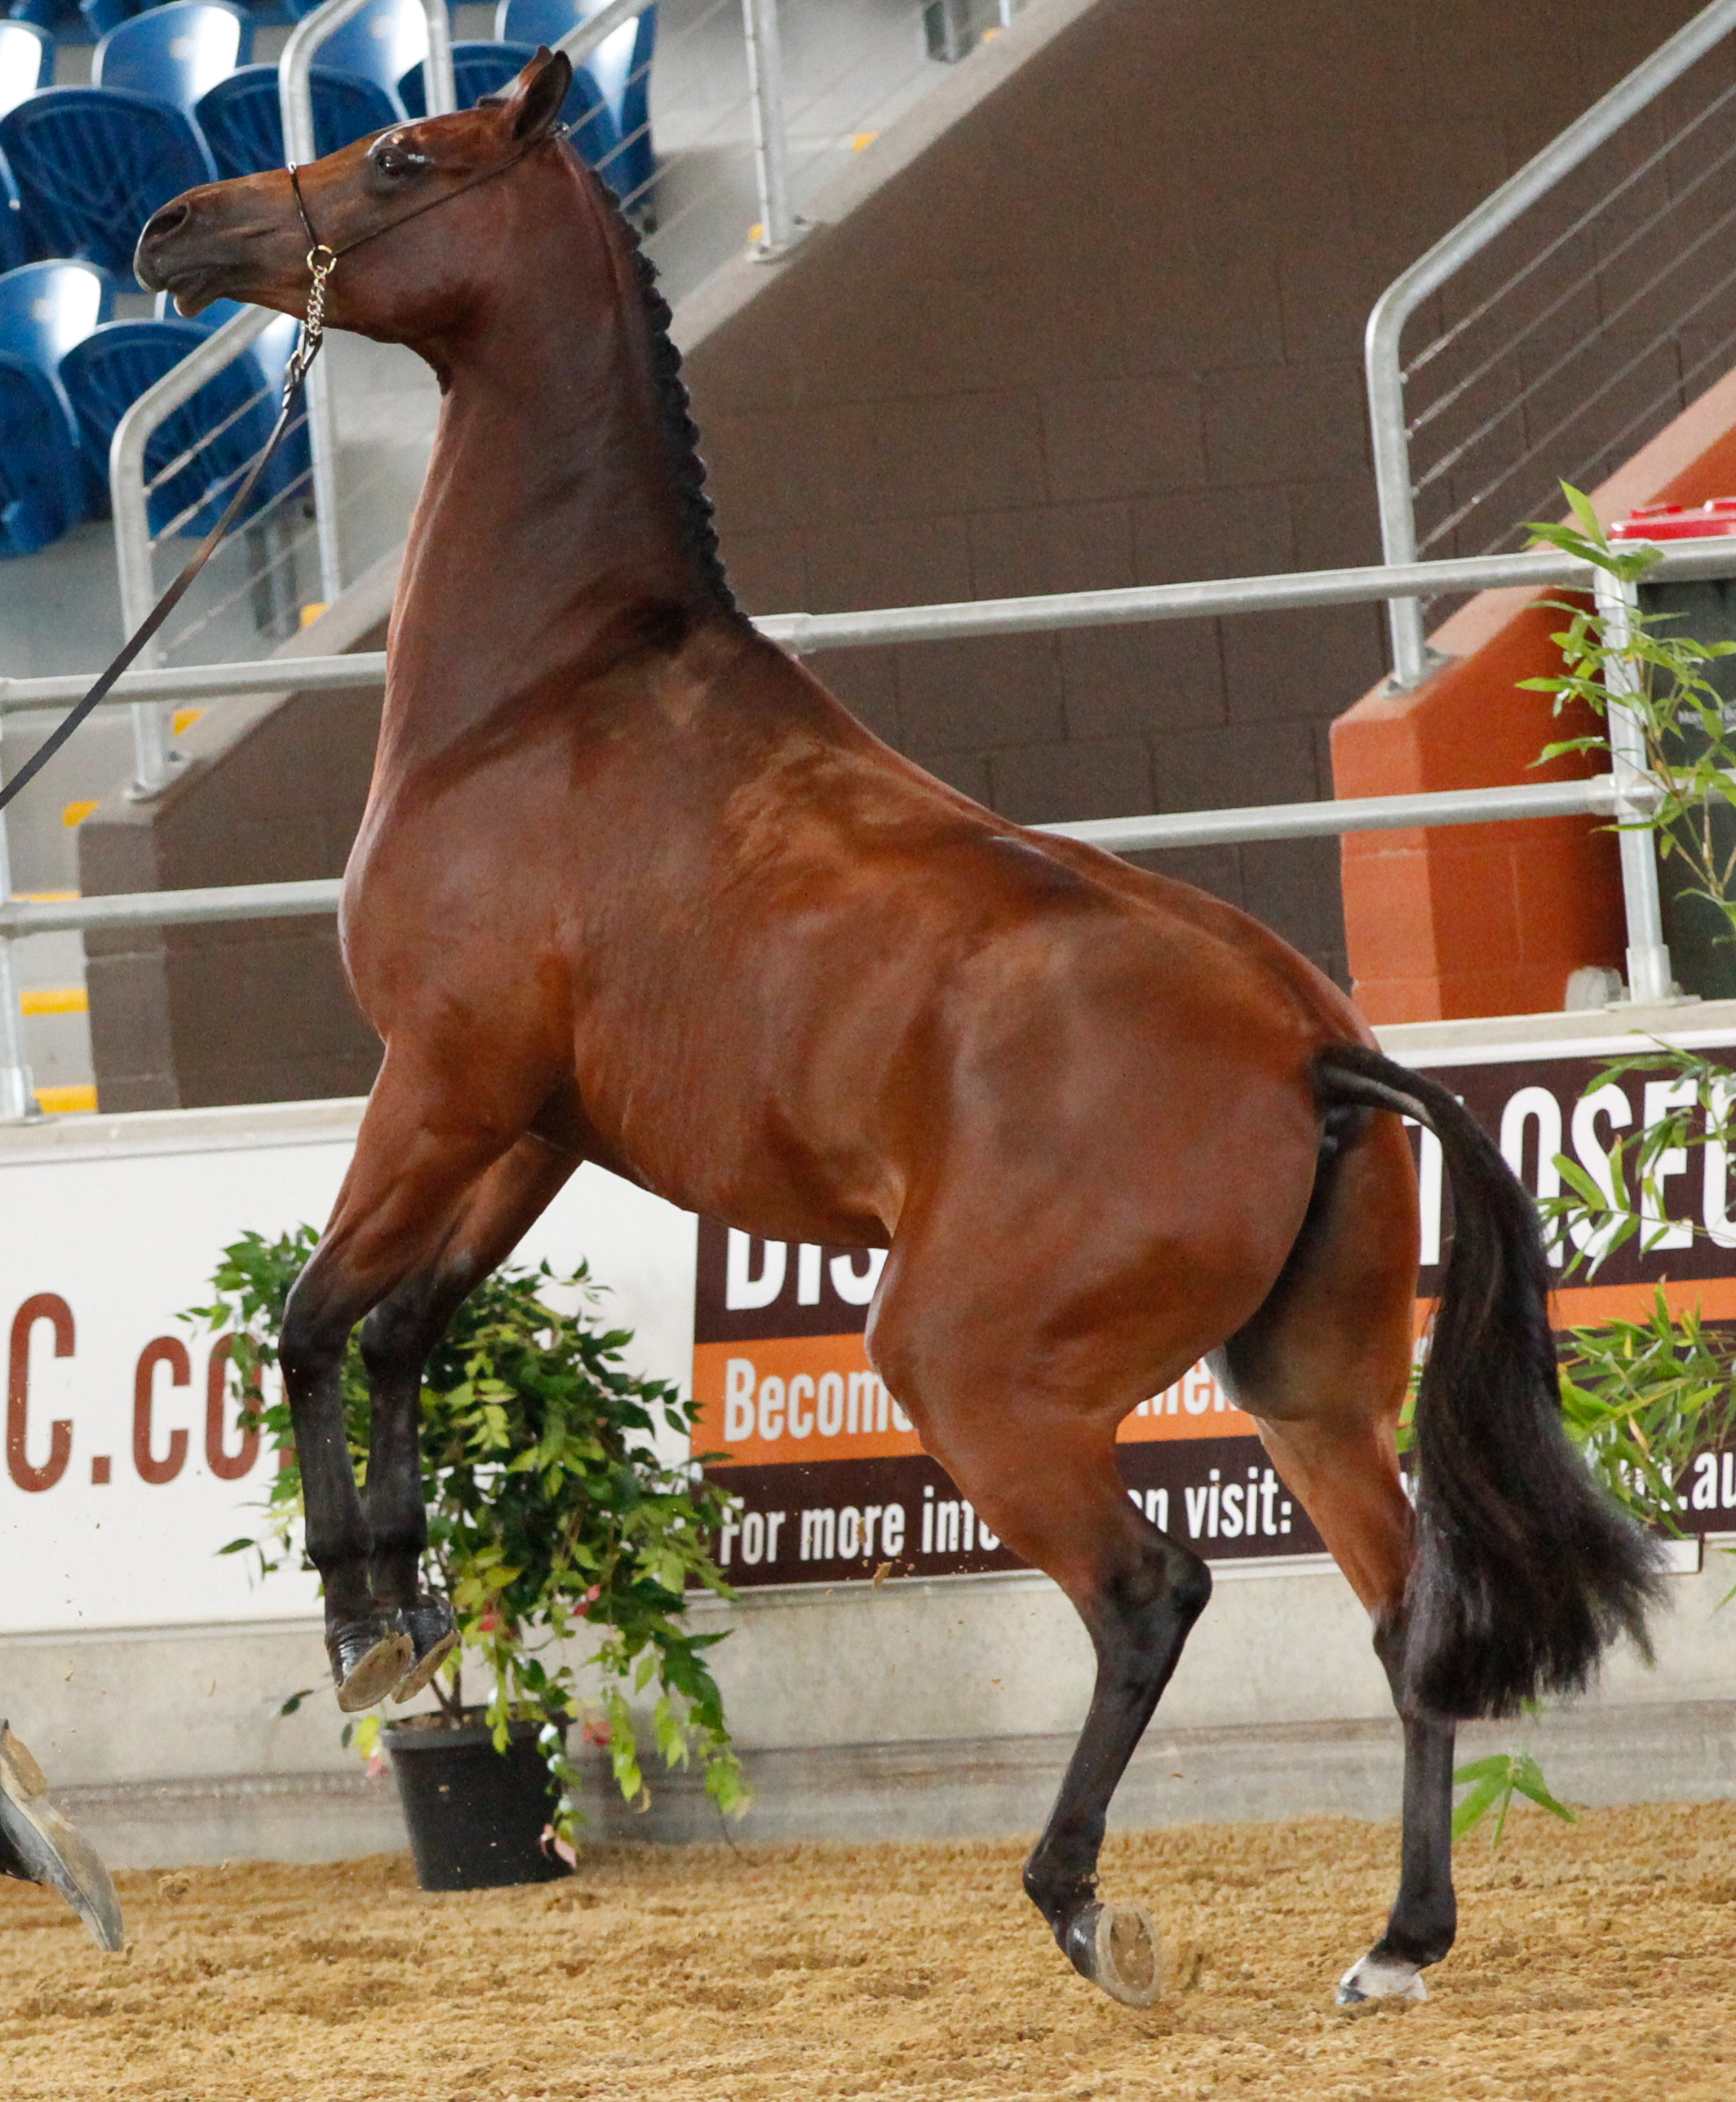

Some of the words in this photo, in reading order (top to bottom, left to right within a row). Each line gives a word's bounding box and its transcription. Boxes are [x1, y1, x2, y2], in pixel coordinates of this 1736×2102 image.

[7, 1292, 295, 1492] C.co
[720, 1496, 786, 1565] For
[799, 1502, 906, 1560] more
[1185, 1466, 1292, 1539] visit:
